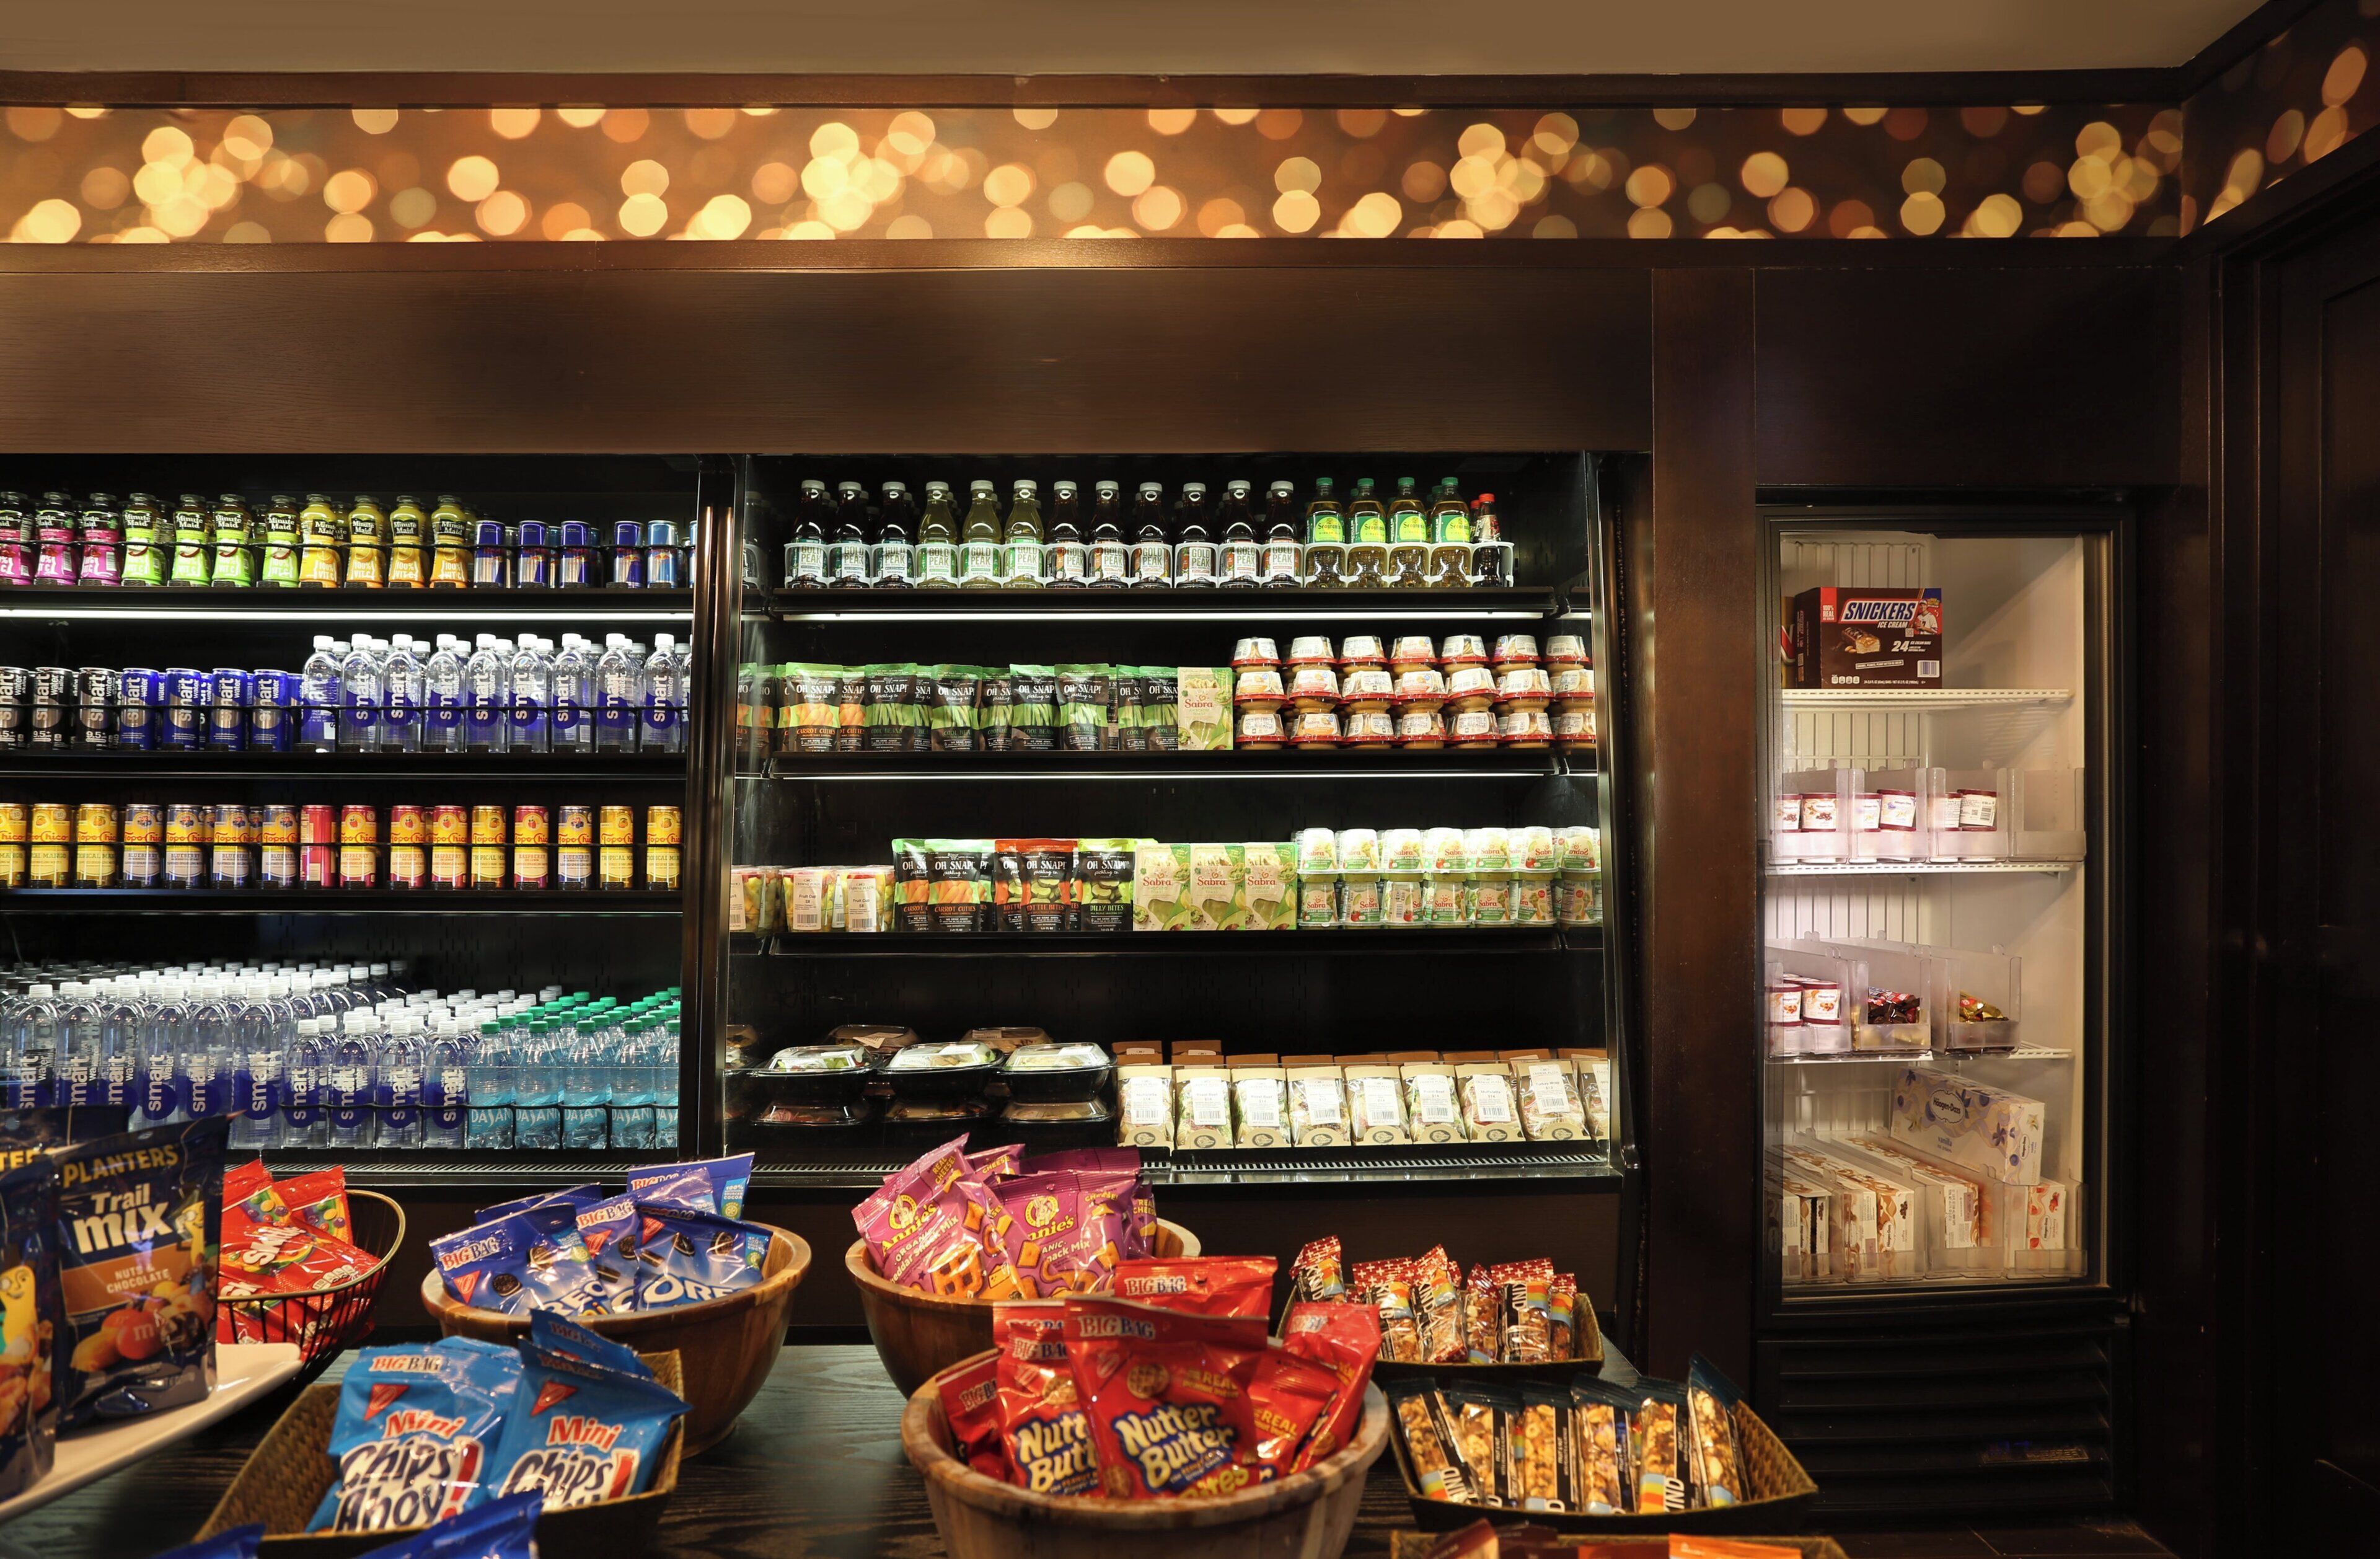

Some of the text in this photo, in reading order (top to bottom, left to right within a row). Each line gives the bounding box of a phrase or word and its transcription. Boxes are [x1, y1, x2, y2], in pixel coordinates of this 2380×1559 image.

[176, 514, 203, 524] Minute
[269, 516, 294, 525] Minute
[353, 520, 374, 528] Minute
[444, 527, 462, 535] Maid
[885, 555, 905, 563] PEAK
[930, 547, 949, 557] GOLD
[971, 547, 990, 556] GOLD
[971, 556, 990, 565] PEAK
[1067, 557, 1084, 566] PEAK
[1143, 547, 1162, 557] GOLD
[1143, 557, 1162, 566] PEAK
[1191, 549, 1210, 559] GOLD
[1191, 558, 1210, 567] PEAK
[1844, 602, 1916, 621] SNICKERS
[1877, 621, 1908, 629] ICE CREAM
[1891, 640, 1910, 652] 24
[36, 673, 50, 721] smart
[89, 674, 106, 722] smart
[438, 673, 454, 720] smart
[796, 684, 835, 694] OH SNAP!
[870, 684, 909, 693] OH SNAP!
[938, 687, 976, 697] OH SNAP!
[1018, 684, 1030, 694] OH
[1064, 686, 1075, 694] OH
[1120, 687, 1130, 696] OH
[219, 678, 235, 721] smart
[653, 675, 668, 723] smart
[1184, 699, 1213, 708] Sabra
[950, 860, 974, 870] SNAP!
[1041, 860, 1065, 870] SNAP!
[1143, 876, 1171, 886] Sabra
[1197, 876, 1227, 886] Sabra
[1247, 876, 1276, 886] Sabra
[1360, 901, 1378, 909] Sabra
[148, 1054, 165, 1111] smart
[190, 1055, 208, 1113] smart
[292, 1067, 307, 1121] smart
[472, 1108, 511, 1127] DASAN
[63, 1144, 179, 1189] PLANTERS
[932, 1155, 948, 1175] REAL
[935, 1155, 956, 1185] CHEESE!
[90, 1183, 151, 1214] Trail
[576, 1201, 636, 1230] BIG BAG
[940, 1215, 959, 1235] Mix
[73, 1199, 174, 1254] mix
[881, 1201, 937, 1256] Annie's
[1027, 1215, 1075, 1241] nnie's
[442, 1236, 500, 1271] BIG BAG
[1046, 1240, 1090, 1264] nack Mix
[106, 1269, 170, 1295] CHOCOLATE
[115, 1266, 155, 1281] NUTS &
[1305, 1265, 1325, 1301] KIND
[643, 1274, 733, 1303] ORE
[1124, 1276, 1187, 1295] BIG BAG
[544, 1281, 606, 1316] REO
[1418, 1280, 1435, 1313] KIND
[1511, 1283, 1527, 1310] KIND
[1077, 1314, 1117, 1338] BIG
[1119, 1316, 1157, 1340] BAG
[370, 1355, 441, 1372] BIG BAG
[384, 1410, 467, 1439] Mini
[1115, 1403, 1217, 1455] Nutter
[1261, 1409, 1298, 1434] REAL
[545, 1415, 622, 1451] Mini
[1019, 1414, 1089, 1464] Nutt
[340, 1438, 454, 1490] Chips
[1029, 1440, 1099, 1493] Butt
[1139, 1426, 1234, 1488] Butter
